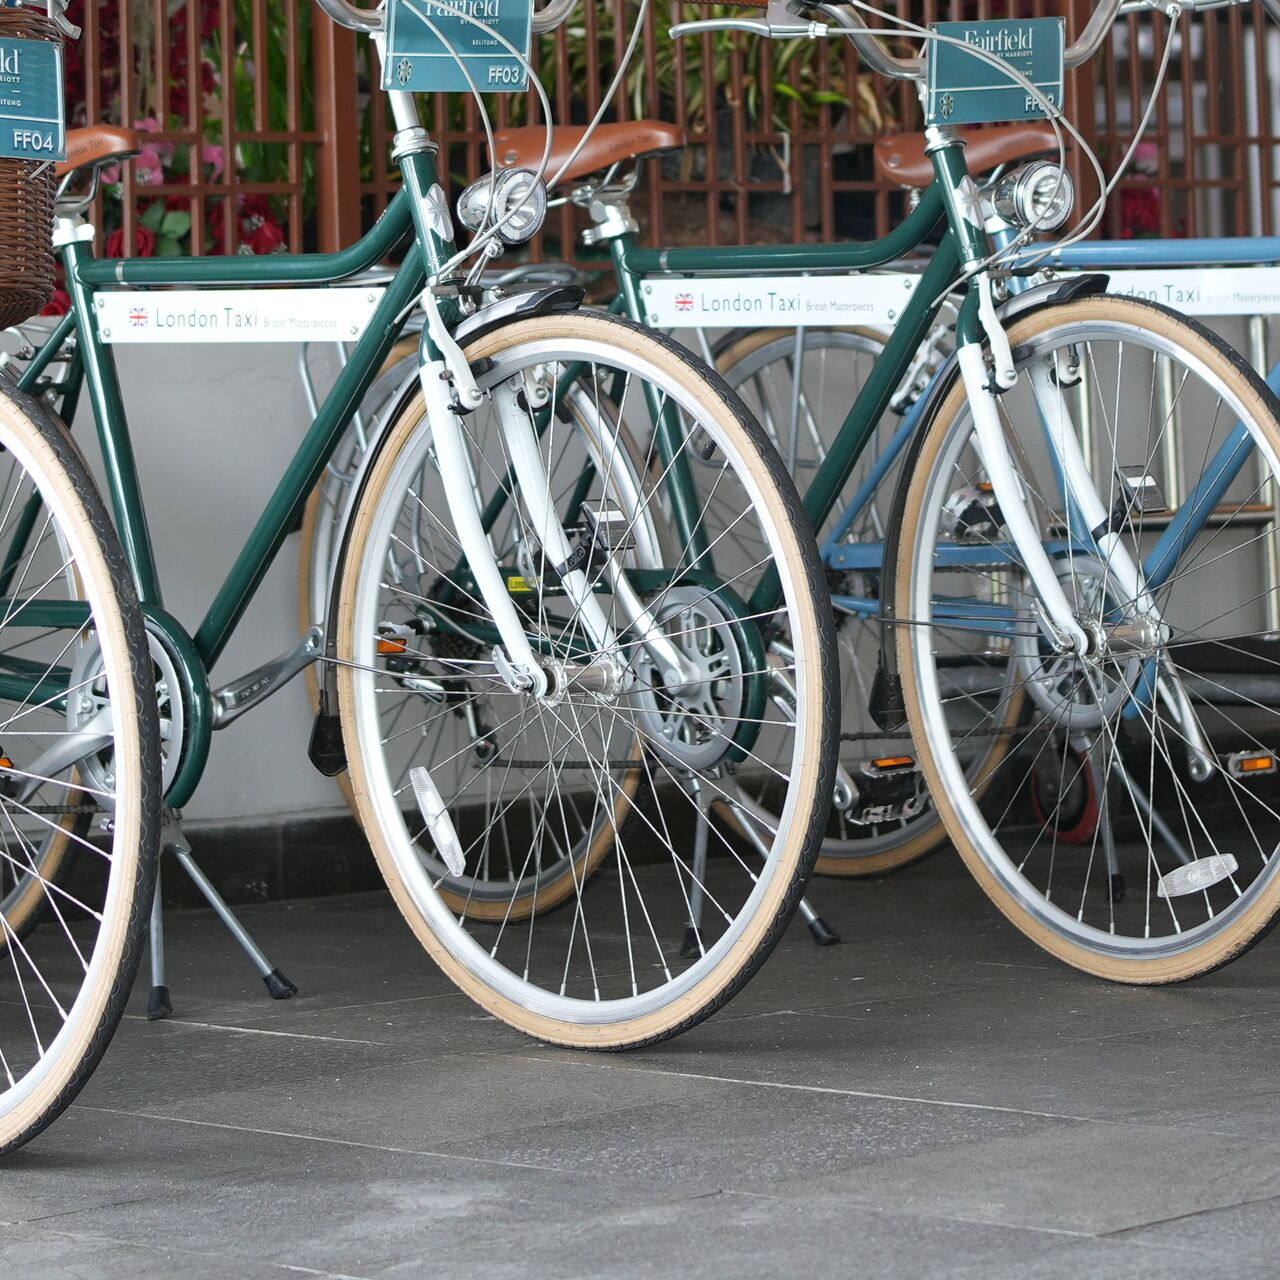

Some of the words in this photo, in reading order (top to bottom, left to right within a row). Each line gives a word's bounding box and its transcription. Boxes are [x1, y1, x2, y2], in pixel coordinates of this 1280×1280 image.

[964, 28, 1033, 51] Fairfield
[488, 67, 520, 84] FF03
[13, 130, 54, 151] FF04
[701, 292, 762, 312] London
[767, 292, 801, 311] Taxi
[806, 301, 828, 311] British
[829, 301, 874, 313] Masterpieces
[1163, 284, 1201, 302] Taxi
[1232, 291, 1280, 304] Masterpieces
[156, 307, 218, 328] London
[224, 307, 258, 328] Taxi
[289, 317, 337, 330] Masterpieces
